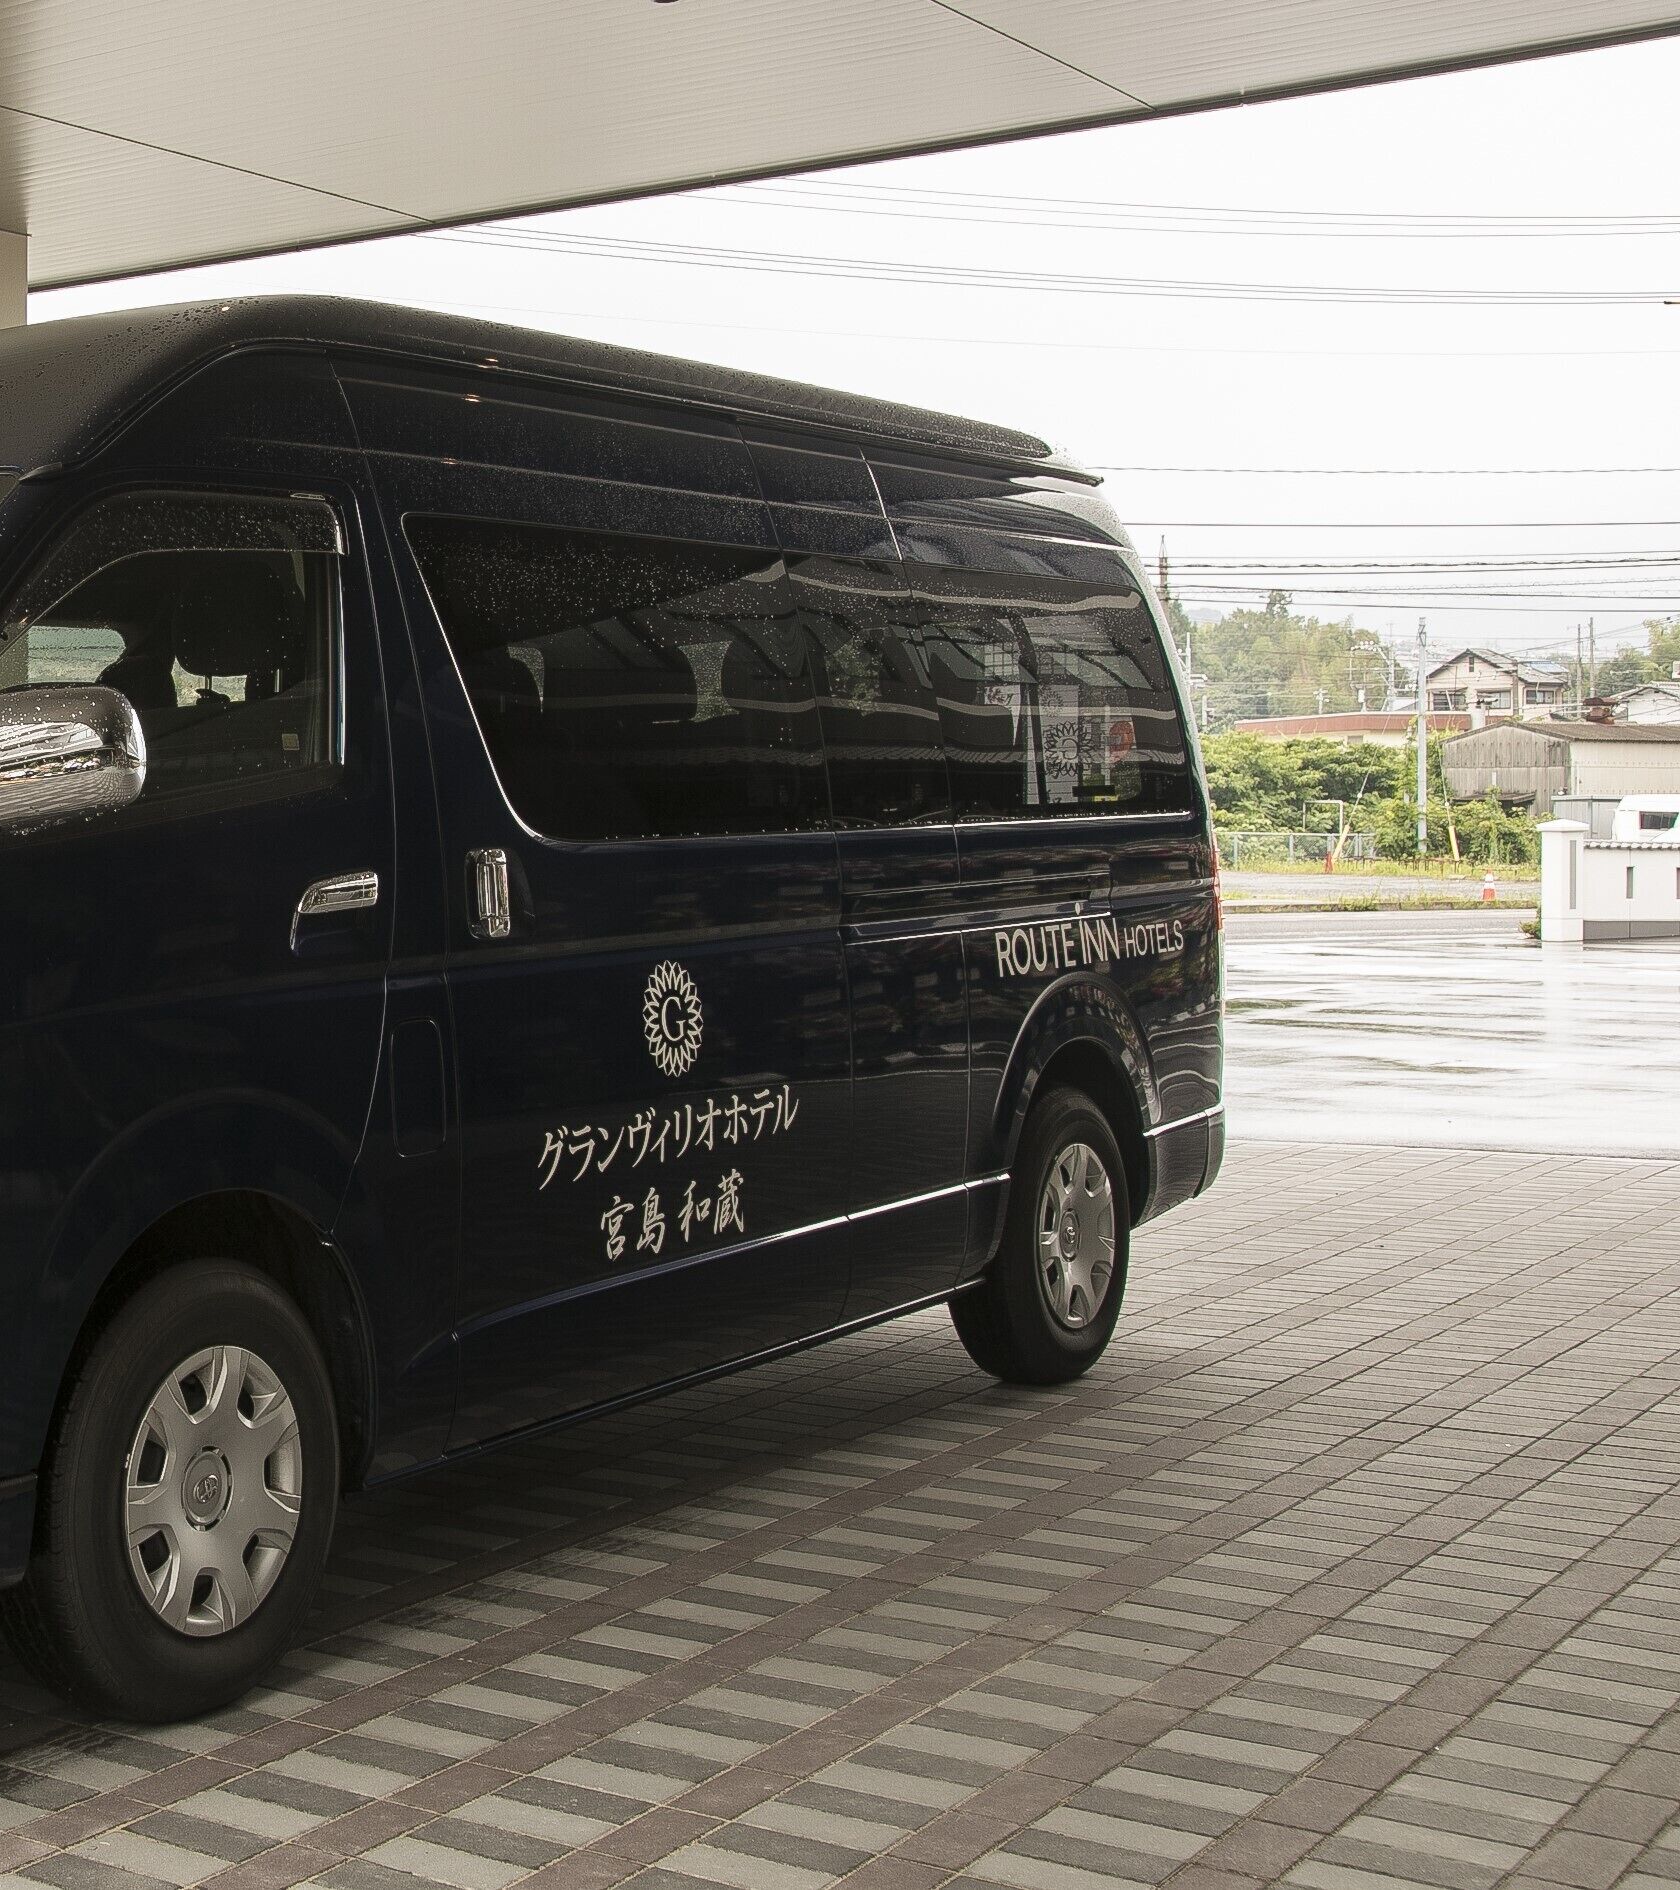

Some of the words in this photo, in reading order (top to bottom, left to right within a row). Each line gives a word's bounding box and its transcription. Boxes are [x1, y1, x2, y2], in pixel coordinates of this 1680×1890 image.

[995, 922, 1077, 977] ROUTE
[1079, 918, 1120, 964] INN
[1123, 919, 1184, 958] HOTELS
[661, 996, 686, 1041] G
[537, 1084, 799, 1191] グランヴィリオホテル
[601, 1187, 665, 1262] 宮島
